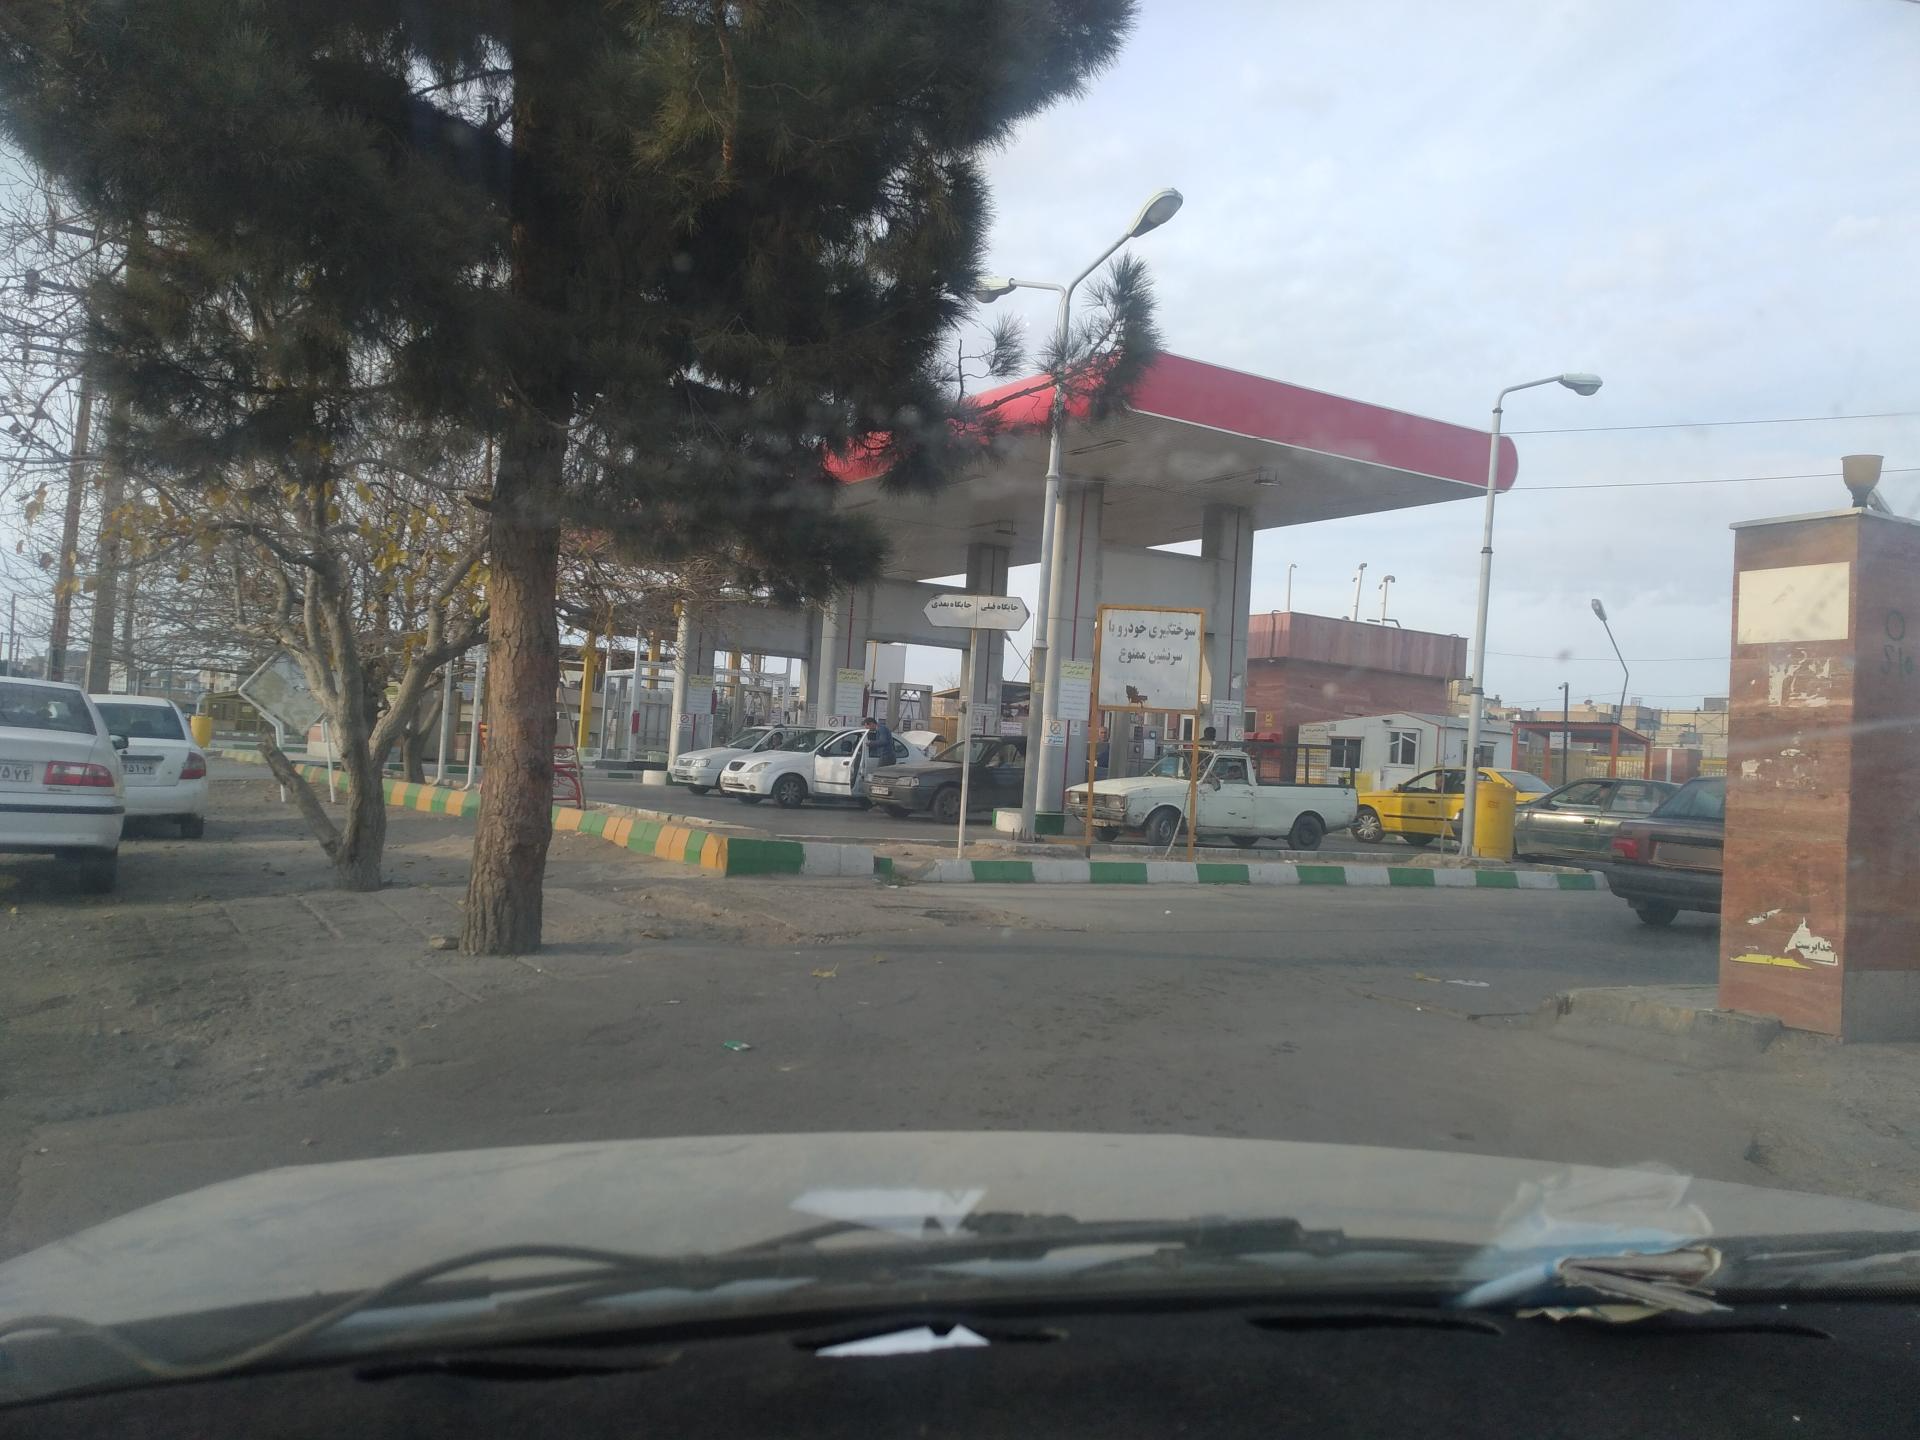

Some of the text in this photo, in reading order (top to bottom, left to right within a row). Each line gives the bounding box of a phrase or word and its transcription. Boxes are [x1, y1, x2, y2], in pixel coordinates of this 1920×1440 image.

[1108, 619, 1196, 640] سوختگیری خودرو با
[1118, 648, 1183, 665] سرنشین ممنوع
